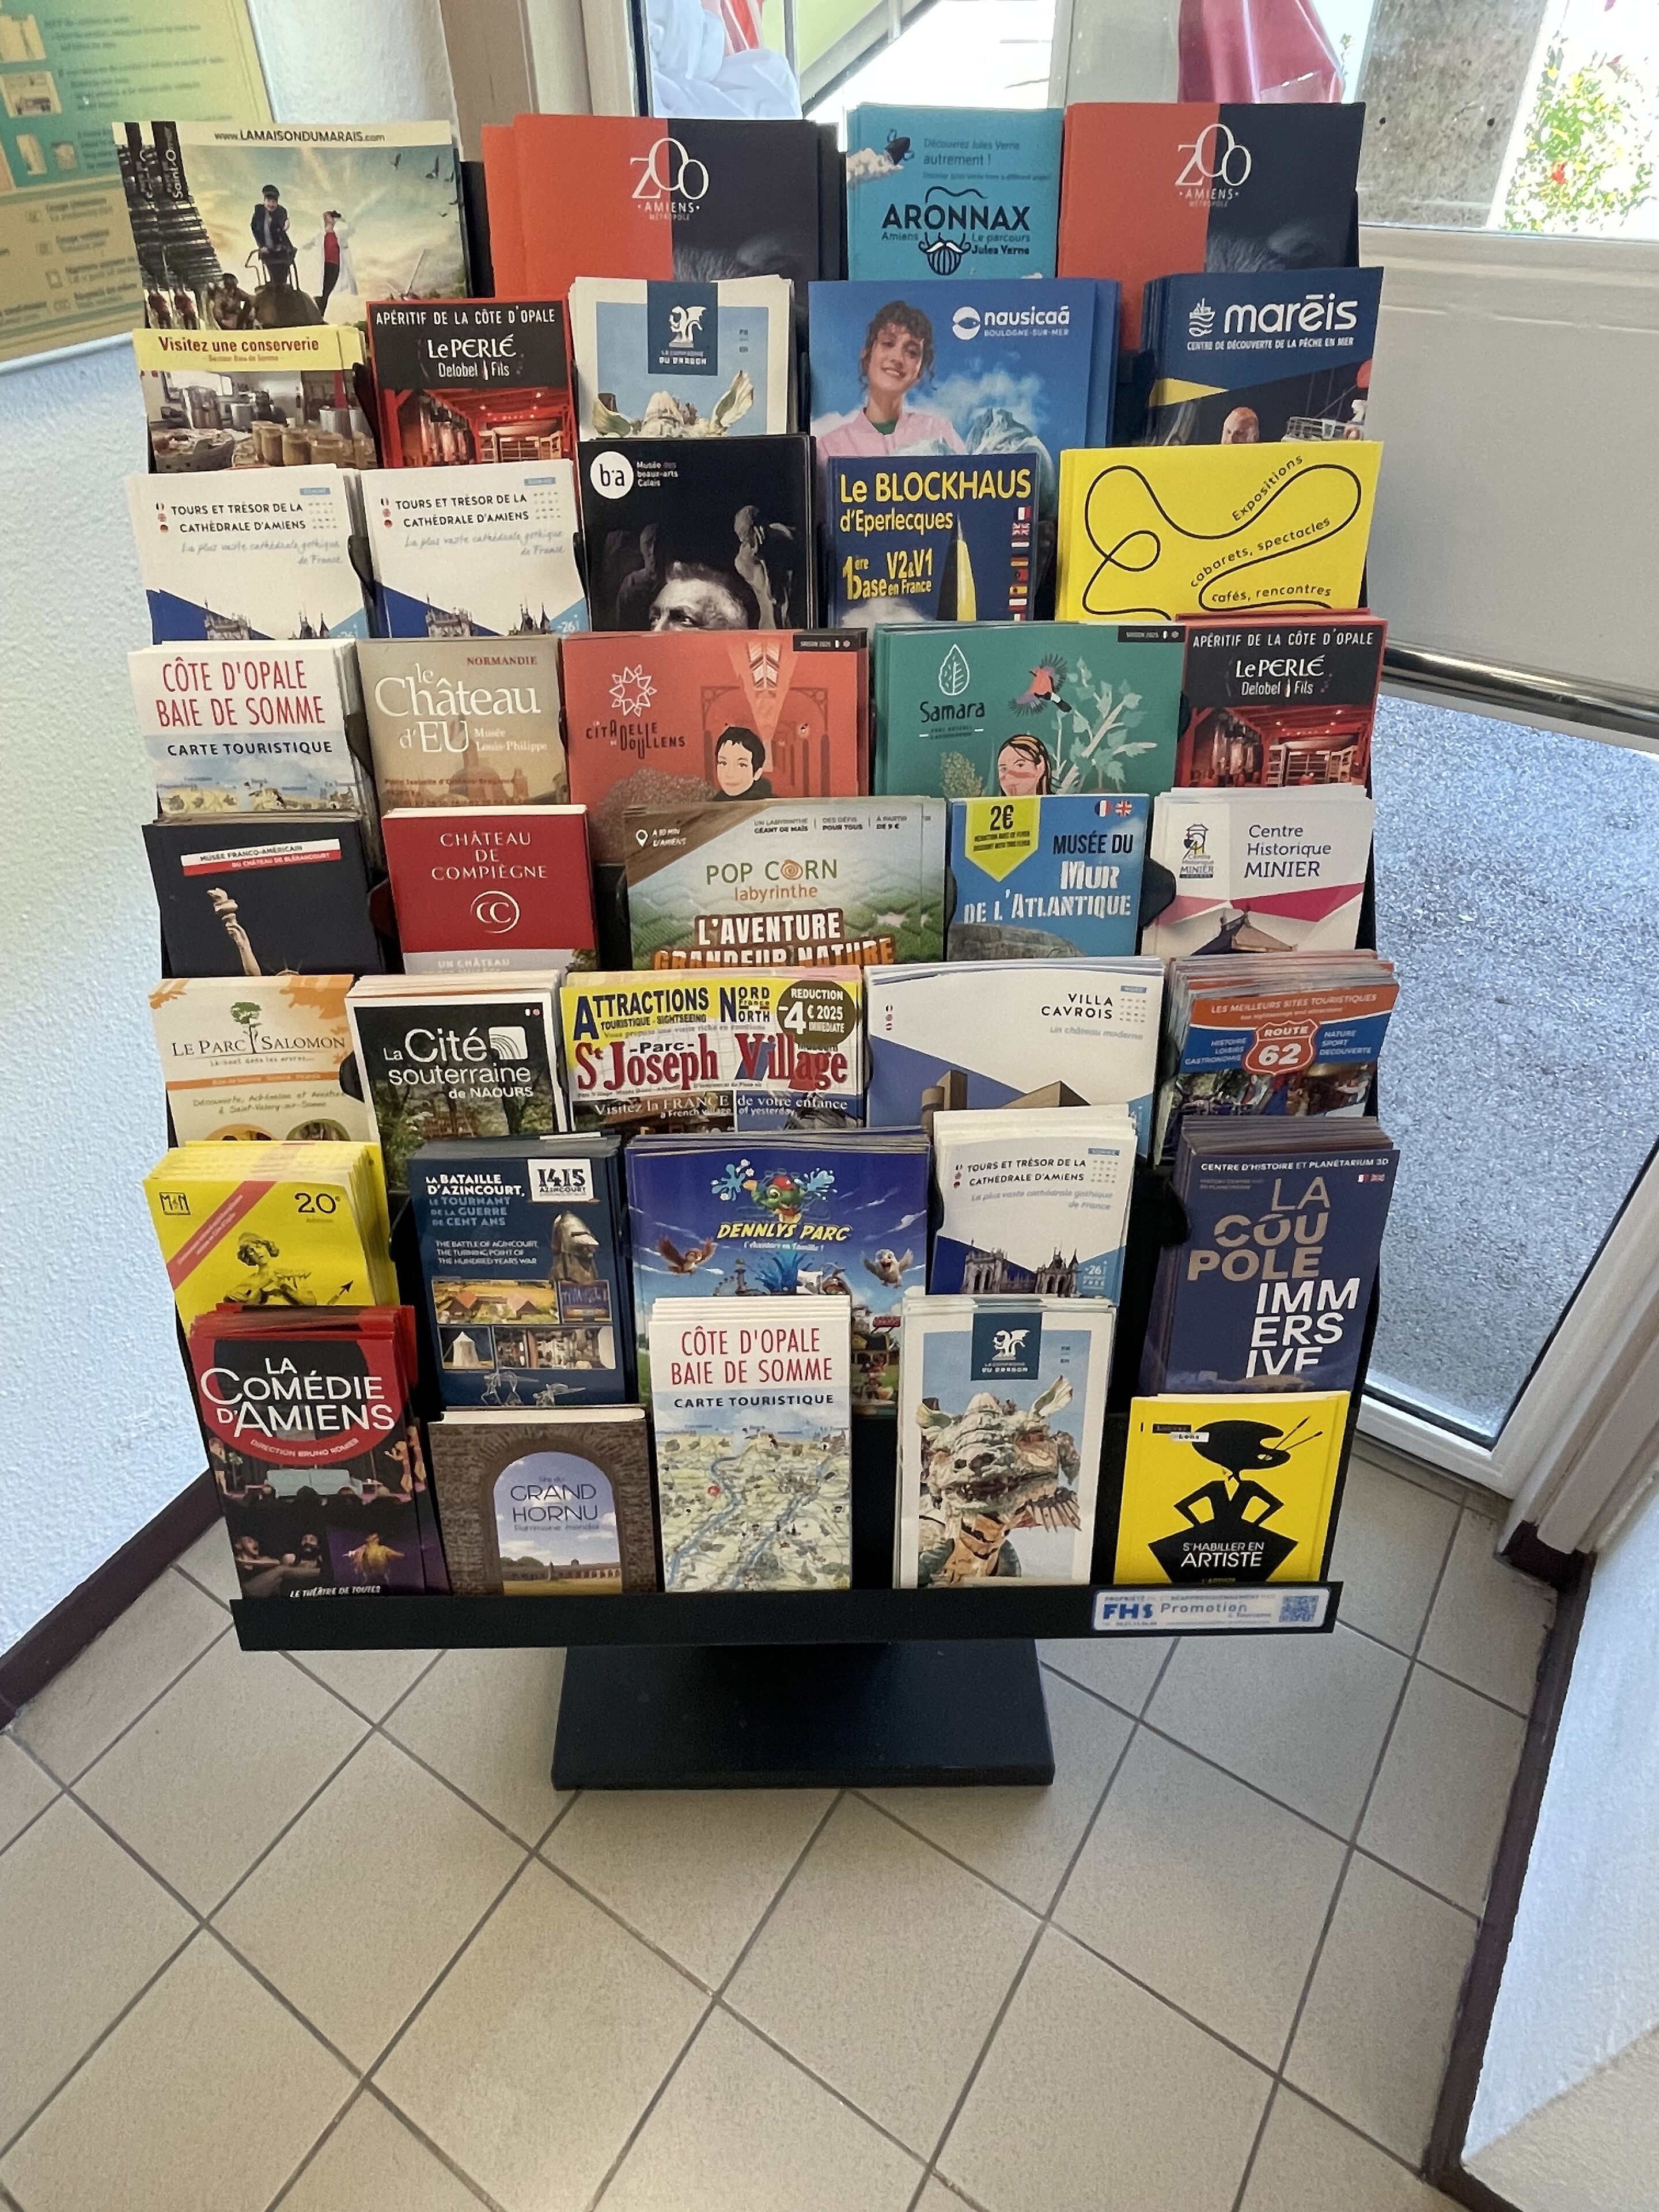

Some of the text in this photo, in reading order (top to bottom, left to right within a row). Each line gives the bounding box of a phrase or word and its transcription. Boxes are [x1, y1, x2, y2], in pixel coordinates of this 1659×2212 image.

[214, 129, 385, 142] www.LAMAISONDUMARAIS.com
[923, 153, 983, 166] autrement
[1185, 188, 1234, 200] AMIENS
[645, 202, 694, 213] AMIENS
[881, 203, 1031, 231] ARONNAX
[881, 232, 918, 241] Amiens
[972, 233, 1031, 244] Le parcours
[972, 245, 1029, 255] Jules Verne
[376, 305, 555, 325] APÉRITIF DE LA CÔTE D'OPALE
[158, 336, 319, 353] Visitez une conserverie
[1187, 337, 1354, 351] CENTRE DE DÉCOUVERTE DE LA PÊCHE EN MER
[438, 361, 510, 378] Delobel Fils
[637, 470, 679, 478] beaux-arts
[839, 468, 1032, 503] Le BLOCKHAUS
[1232, 455, 1304, 522] Expositions
[171, 501, 302, 516] TOURS ET TRÉSOR DE LA
[180, 520, 306, 533] CATHÉDRALE D'AMIENS
[840, 507, 953, 537] d'Eperlecques
[1190, 517, 1331, 588] cabarets, spectacles
[1211, 584, 1332, 603] cafés, rencontres
[467, 656, 537, 666] NORMANDIE
[162, 656, 307, 692] CÔTE D'OPALE
[415, 663, 433, 684] le
[375, 676, 541, 717] Château
[156, 696, 325, 728] BAIE DE SOMME
[920, 701, 985, 723] Samara
[399, 720, 469, 753] d'EU
[474, 728, 506, 738] Musée
[167, 741, 332, 756] CARTE TOURISTIQUE
[990, 805, 1014, 831] 2€
[440, 831, 531, 847] CHÂTEAU
[1249, 824, 1304, 838] Centre
[1053, 830, 1108, 854] MUSÉE
[1112, 834, 1134, 854] DU
[1247, 843, 1331, 858] Historique
[200, 853, 225, 862] MUSÉE
[475, 850, 499, 863] DE
[431, 864, 547, 881] COMPIÈGNE
[706, 859, 838, 885] POP CORN
[1060, 860, 1120, 890] MUR
[1244, 861, 1320, 878] MINIER
[734, 885, 818, 904] labyrinthe
[964, 889, 1131, 925] DE L'ATLANTIQUE
[698, 912, 841, 946] L'AVENTURE
[791, 988, 844, 1001] REDUCTION
[1068, 993, 1113, 1006] VILLA
[808, 1005, 814, 1020] €
[817, 1006, 843, 1020] 2025
[1211, 994, 1377, 1014] LES MEILLEURS SITES TOURISTIQUES
[573, 987, 710, 1040] ATTRACTIONS
[1041, 1006, 1112, 1020] CAVROIS
[600, 1014, 706, 1031] TOURISTIQUE SIGHTSEEING
[1264, 1026, 1309, 1037] ROUTE
[172, 1036, 345, 1057] LE PARC SALOMON
[383, 1027, 487, 1062] La Cité
[1211, 1037, 1247, 1047] HISTOIRE
[1215, 1047, 1244, 1055] LOISIRS
[1259, 1043, 1301, 1066] 62
[604, 1033, 719, 1091] Joseph
[734, 1031, 849, 1092] Village
[1185, 1055, 1241, 1065] GASTRONOMIE
[388, 1063, 531, 1085] souterraine
[449, 1086, 534, 1099] de NAOURS
[594, 1100, 643, 1116] Visitez
[647, 1099, 658, 1111] la
[738, 1096, 755, 1108] de
[758, 1096, 791, 1108] votre
[796, 1096, 849, 1111] enfance
[1201, 1158, 1389, 1171] CENTRE D'HISTOIRE ET PLANÉTARIUM 3D
[440, 1174, 502, 1184] BATAILLE
[427, 1185, 525, 1197] D'AZINCOURT,
[1271, 1176, 1331, 1211] LA
[717, 1222, 852, 1241] DENNLYS PARC
[1214, 1212, 1329, 1248] COU
[1187, 1247, 1323, 1281] POLE
[1256, 1278, 1361, 1315] IMM
[1251, 1312, 1344, 1347] ERS
[681, 1325, 820, 1356] CÔTE D'OPALE
[265, 1357, 297, 1374] LA
[671, 1358, 833, 1385] BAIE DE SOMME
[200, 1370, 385, 1405] COMÉDIE
[674, 1395, 834, 1408] CARTE TOURISTIQUE
[217, 1401, 395, 1438] D'AMIENS
[510, 1484, 596, 1501] GRAND
[513, 1505, 598, 1522] HORNU
[1183, 1541, 1264, 1552] S'HABILLER EN
[1181, 1552, 1263, 1568] ARTISTE
[1103, 1602, 1248, 1619] FHS Promotion
